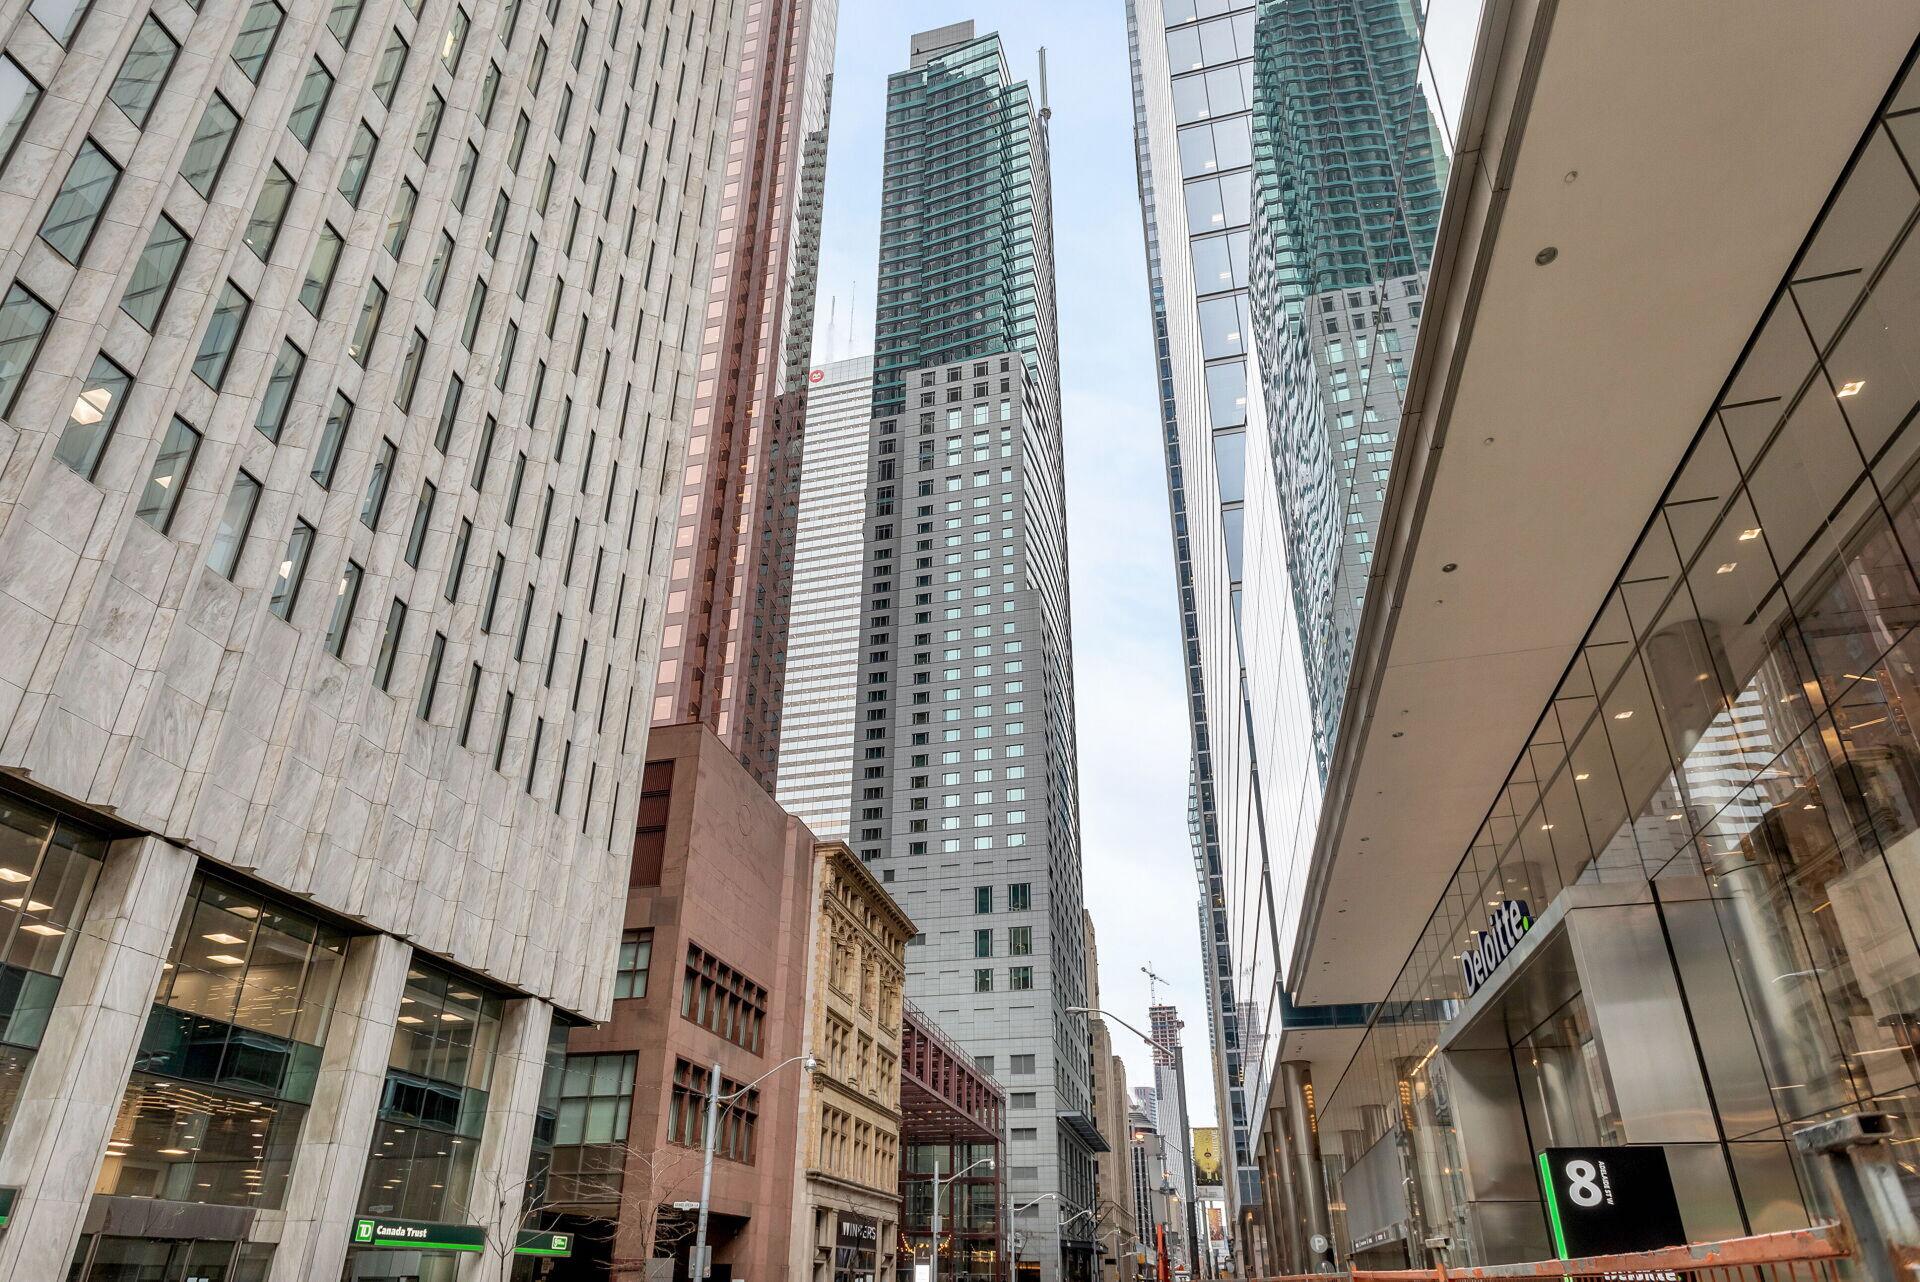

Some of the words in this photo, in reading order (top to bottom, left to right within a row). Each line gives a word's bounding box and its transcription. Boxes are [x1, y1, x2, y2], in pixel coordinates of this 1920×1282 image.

[1598, 1160, 1611, 1189] ADELAIDE
[1565, 1159, 1603, 1207] 8
[1604, 1189, 1613, 1198] ST
[1606, 1197, 1615, 1206] W
[359, 1224, 371, 1238] TD
[376, 1225, 405, 1238] Canada
[406, 1227, 428, 1238] Trust
[1314, 1237, 1324, 1250] P
